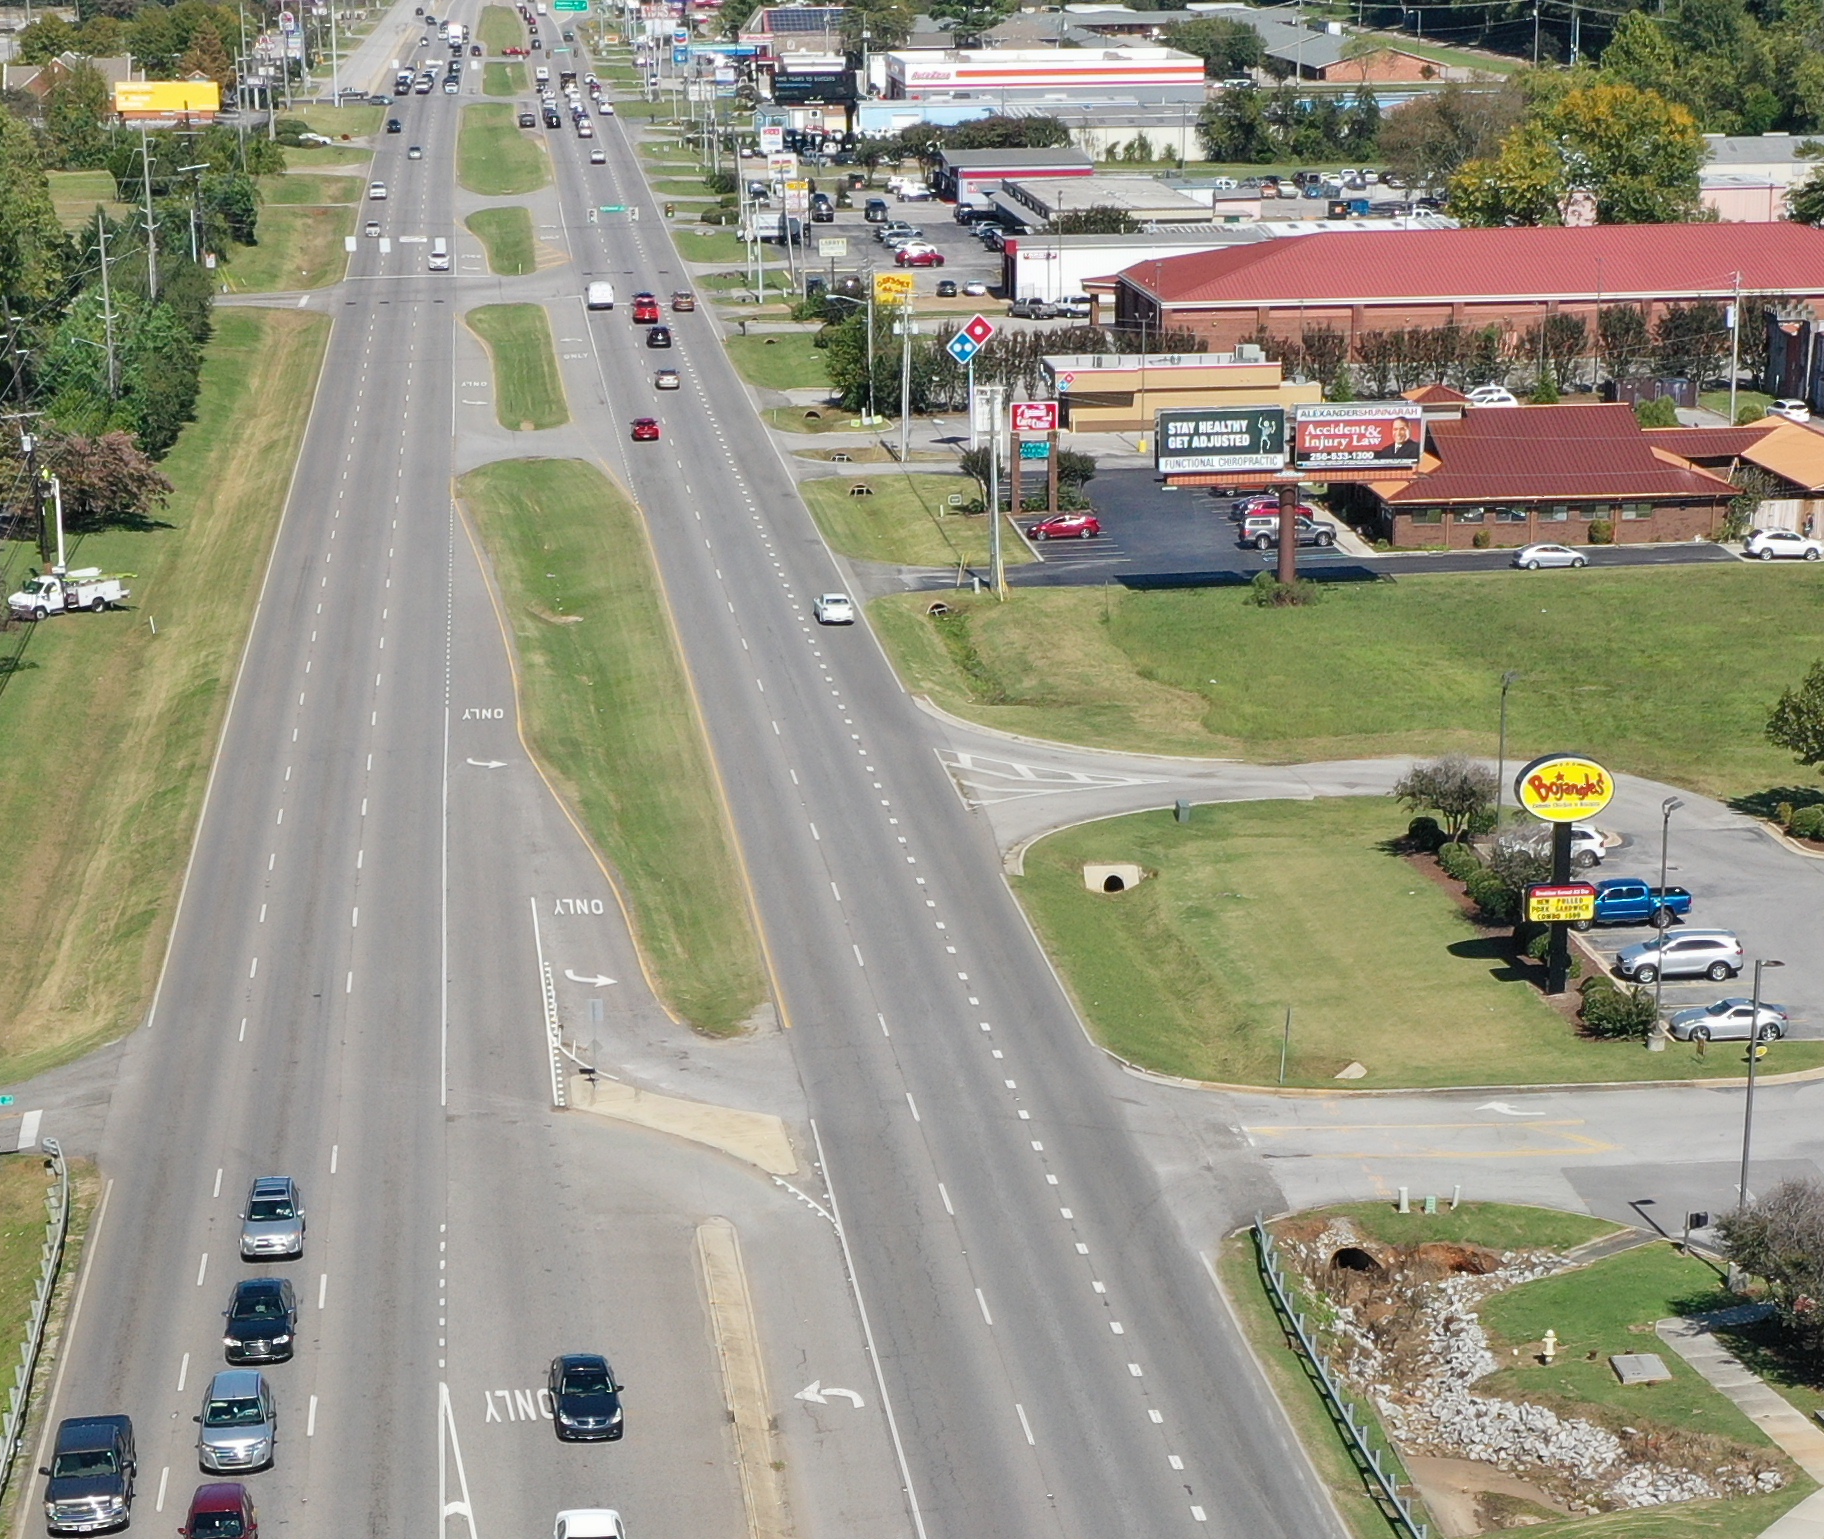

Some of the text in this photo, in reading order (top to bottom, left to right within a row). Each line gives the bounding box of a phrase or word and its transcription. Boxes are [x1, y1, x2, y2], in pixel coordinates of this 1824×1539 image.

[911, 70, 951, 80] AutoZone
[1167, 419, 1248, 435] STAY HEALTHY
[1305, 423, 1366, 435] Accident
[1167, 434, 1250, 449] GET ADJUSTED
[1304, 435, 1382, 450] Injury Law
[1164, 456, 1278, 470] FUNCTIONAL CHIROPRACTIC
[462, 708, 504, 720] ONLY
[554, 898, 605, 916] ONLY
